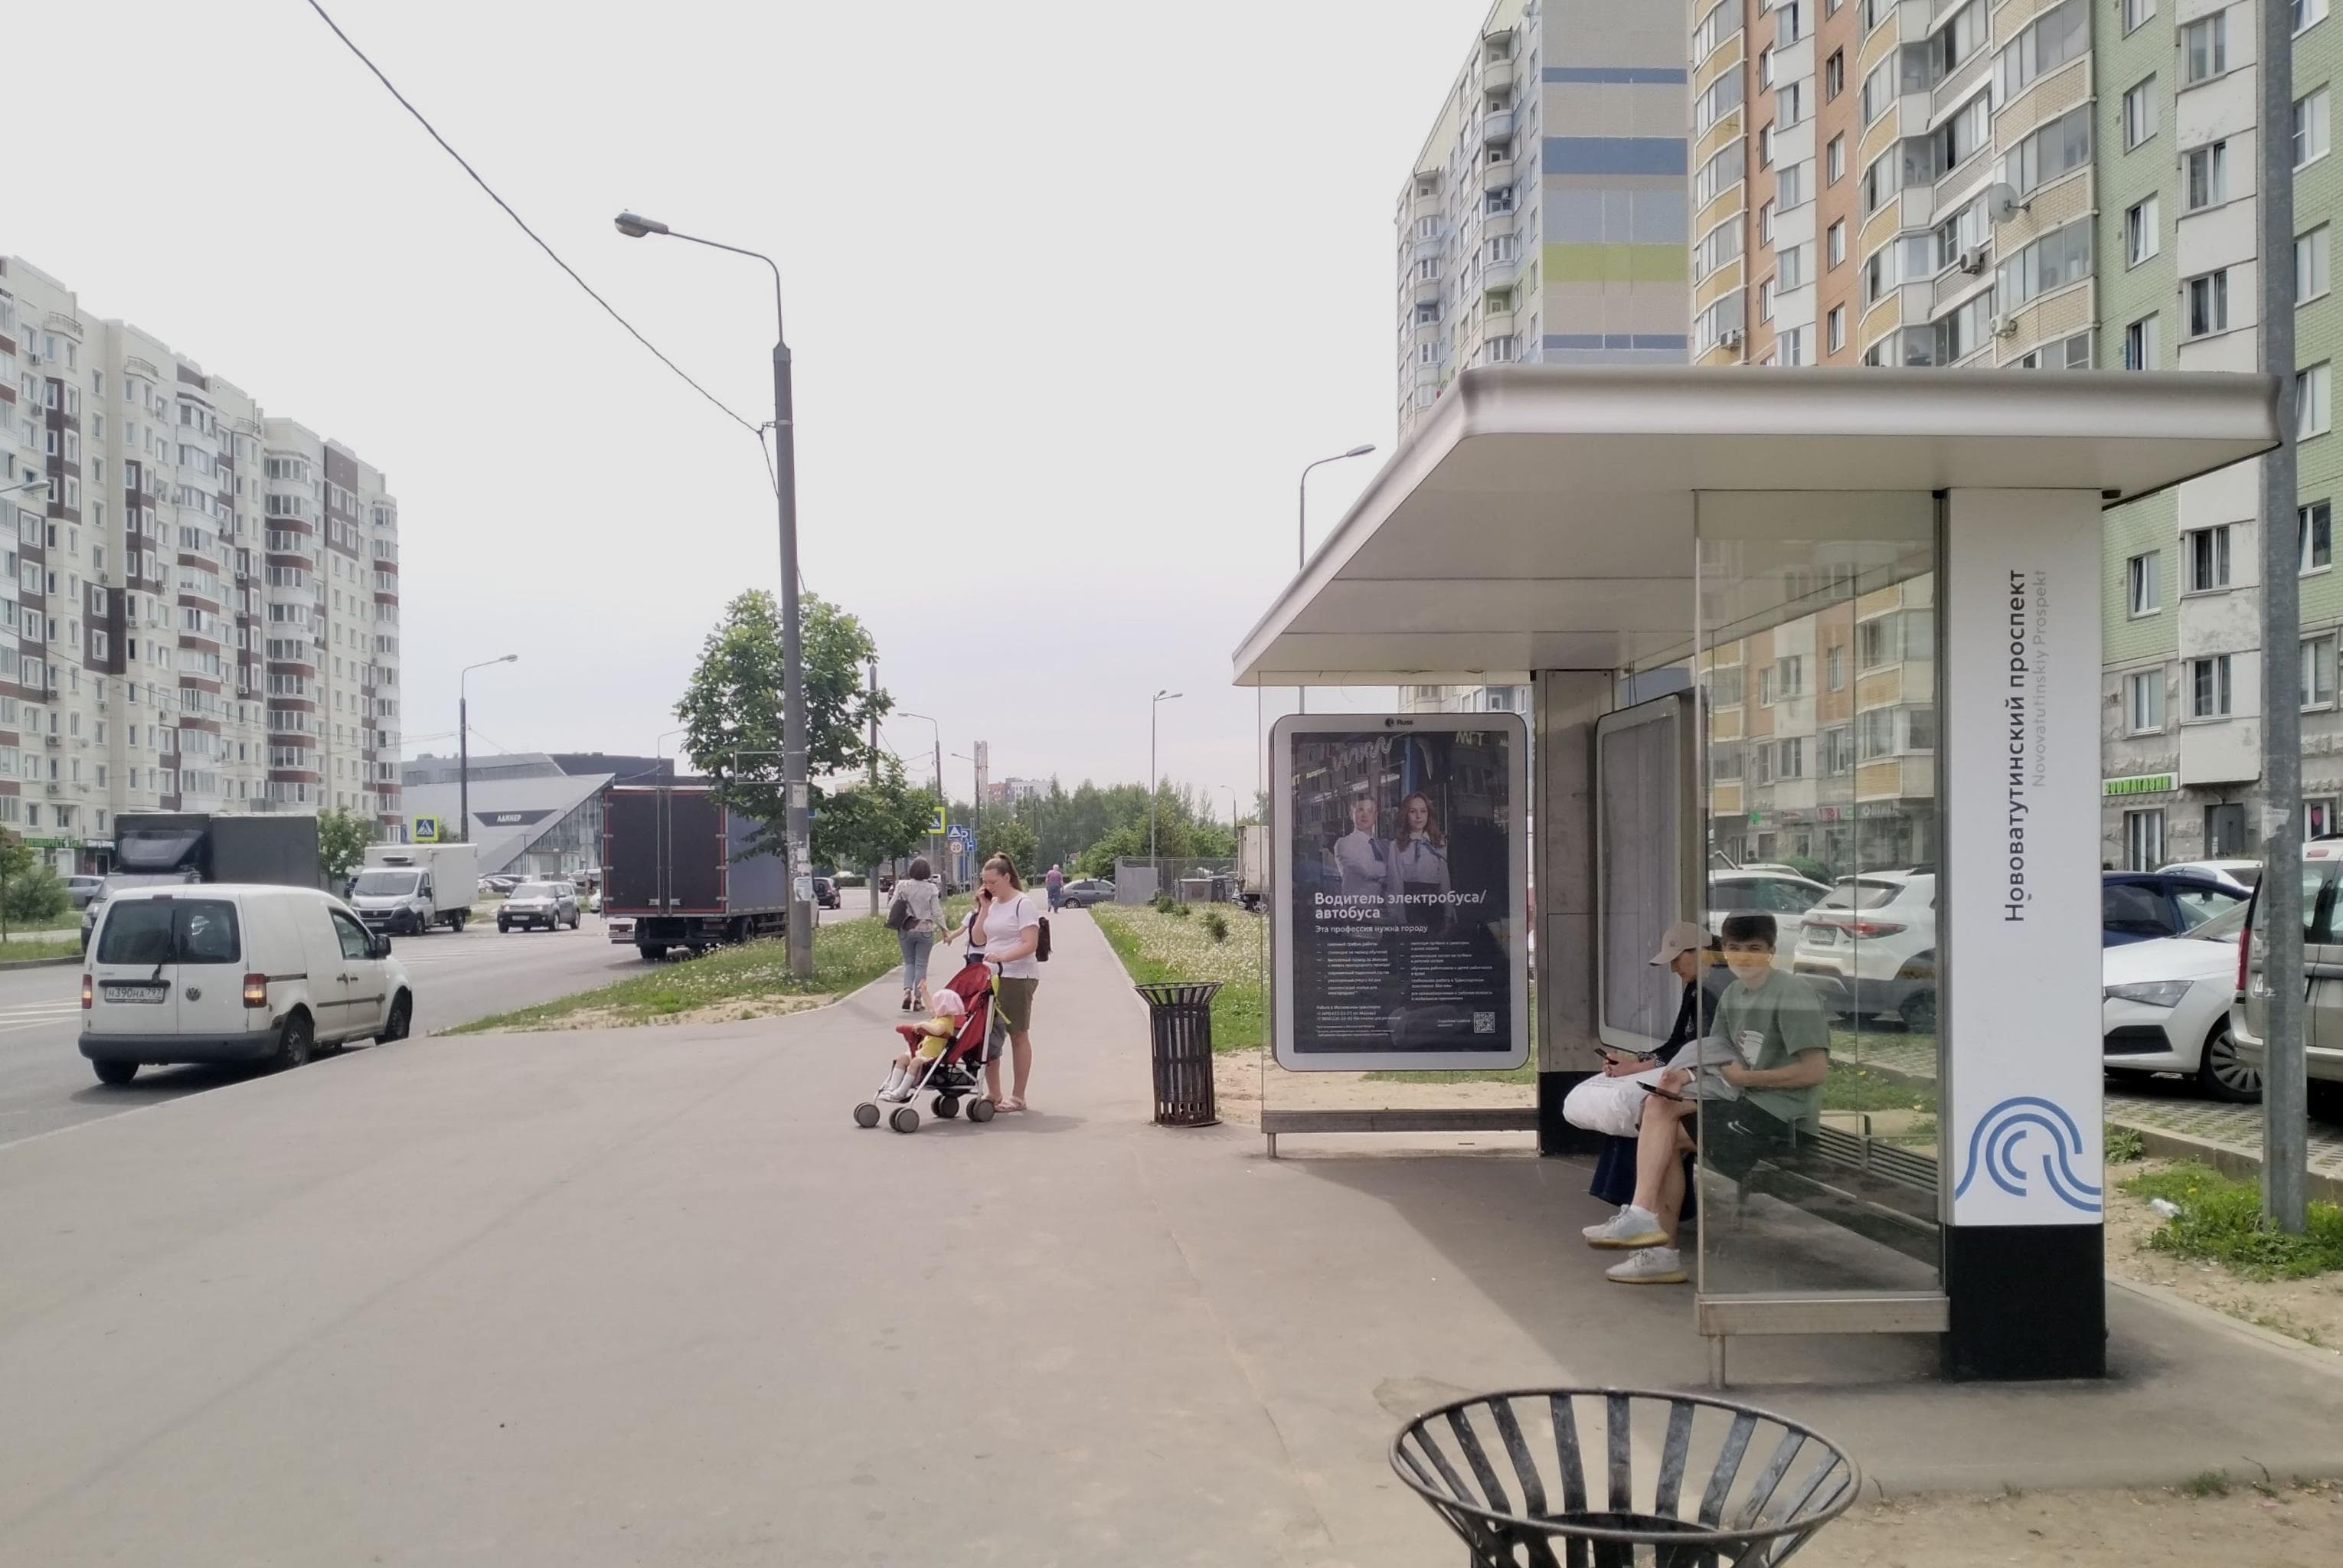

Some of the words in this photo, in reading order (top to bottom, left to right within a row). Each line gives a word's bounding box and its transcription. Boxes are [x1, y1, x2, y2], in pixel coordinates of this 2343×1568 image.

[2010, 570, 2029, 688] проспект
[2033, 570, 2049, 645] Prospekt
[2032, 650, 2049, 787] Novovatutinskiy
[2005, 697, 2029, 922] Нововатутинский
[1315, 892, 1384, 906] Водитель
[1388, 890, 1487, 906] электробуса/
[1315, 906, 1381, 921] автобуса
[1315, 925, 1329, 933] Эта
[1330, 925, 1373, 934] профессия
[1401, 925, 1429, 933] городу
